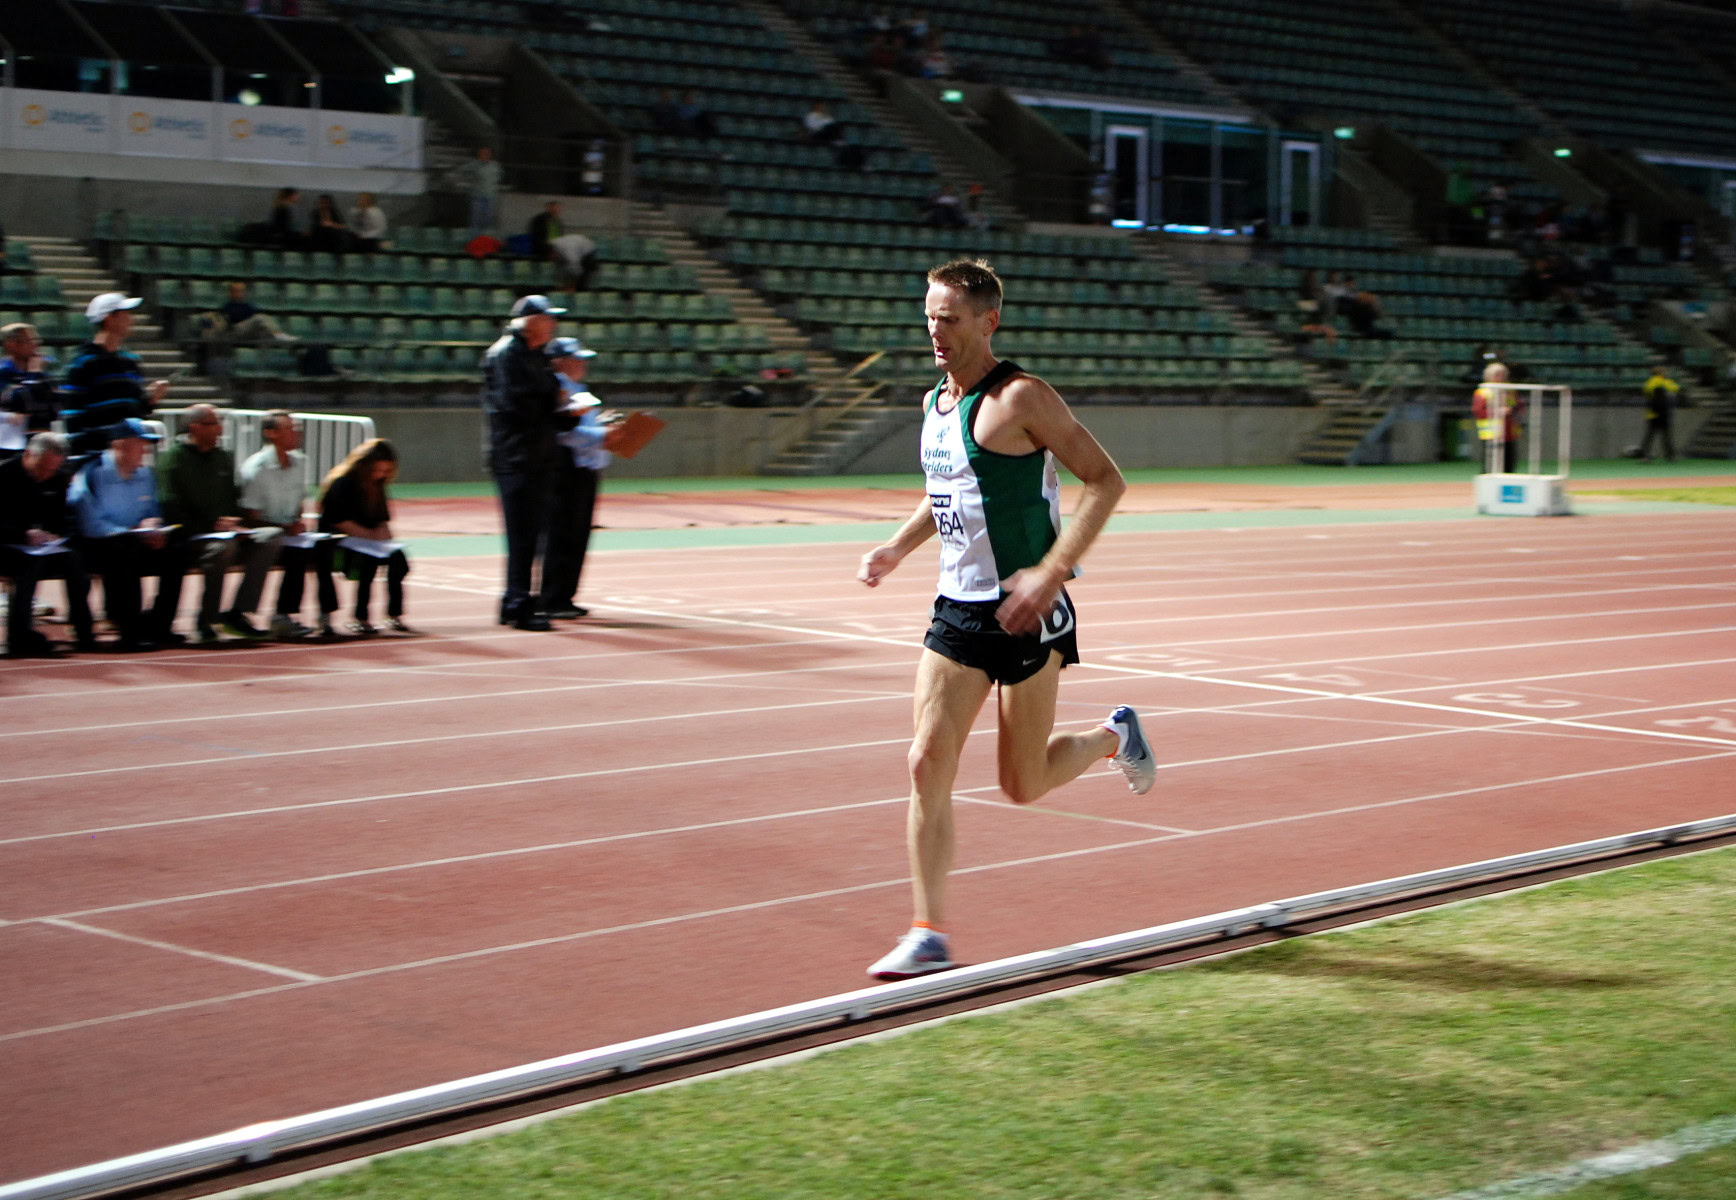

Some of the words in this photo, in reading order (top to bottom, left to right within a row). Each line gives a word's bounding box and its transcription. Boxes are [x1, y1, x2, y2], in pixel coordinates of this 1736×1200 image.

[924, 447, 950, 460] Sydney
[935, 511, 964, 535] 264
[1450, 692, 1583, 709] 3
